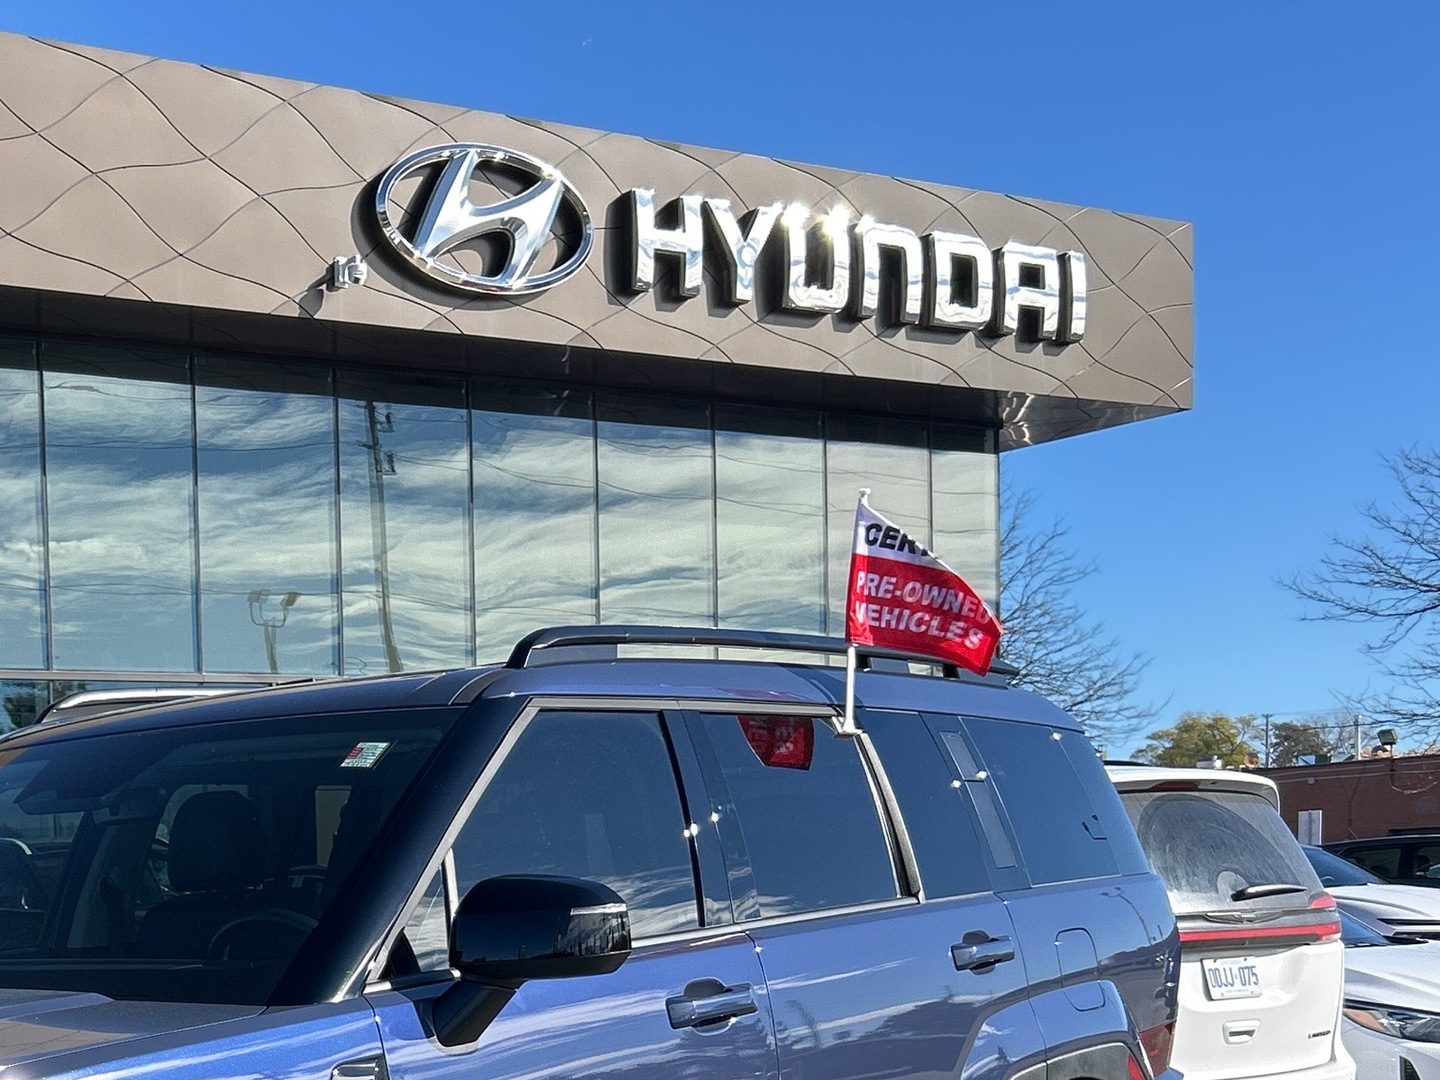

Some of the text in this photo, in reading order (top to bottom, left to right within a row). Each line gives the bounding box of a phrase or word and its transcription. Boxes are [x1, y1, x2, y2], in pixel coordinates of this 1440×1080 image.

[628, 188, 1088, 343] HYUNDAI
[856, 571, 991, 625] PRE-OWNED
[855, 601, 985, 650] VEHICLES
